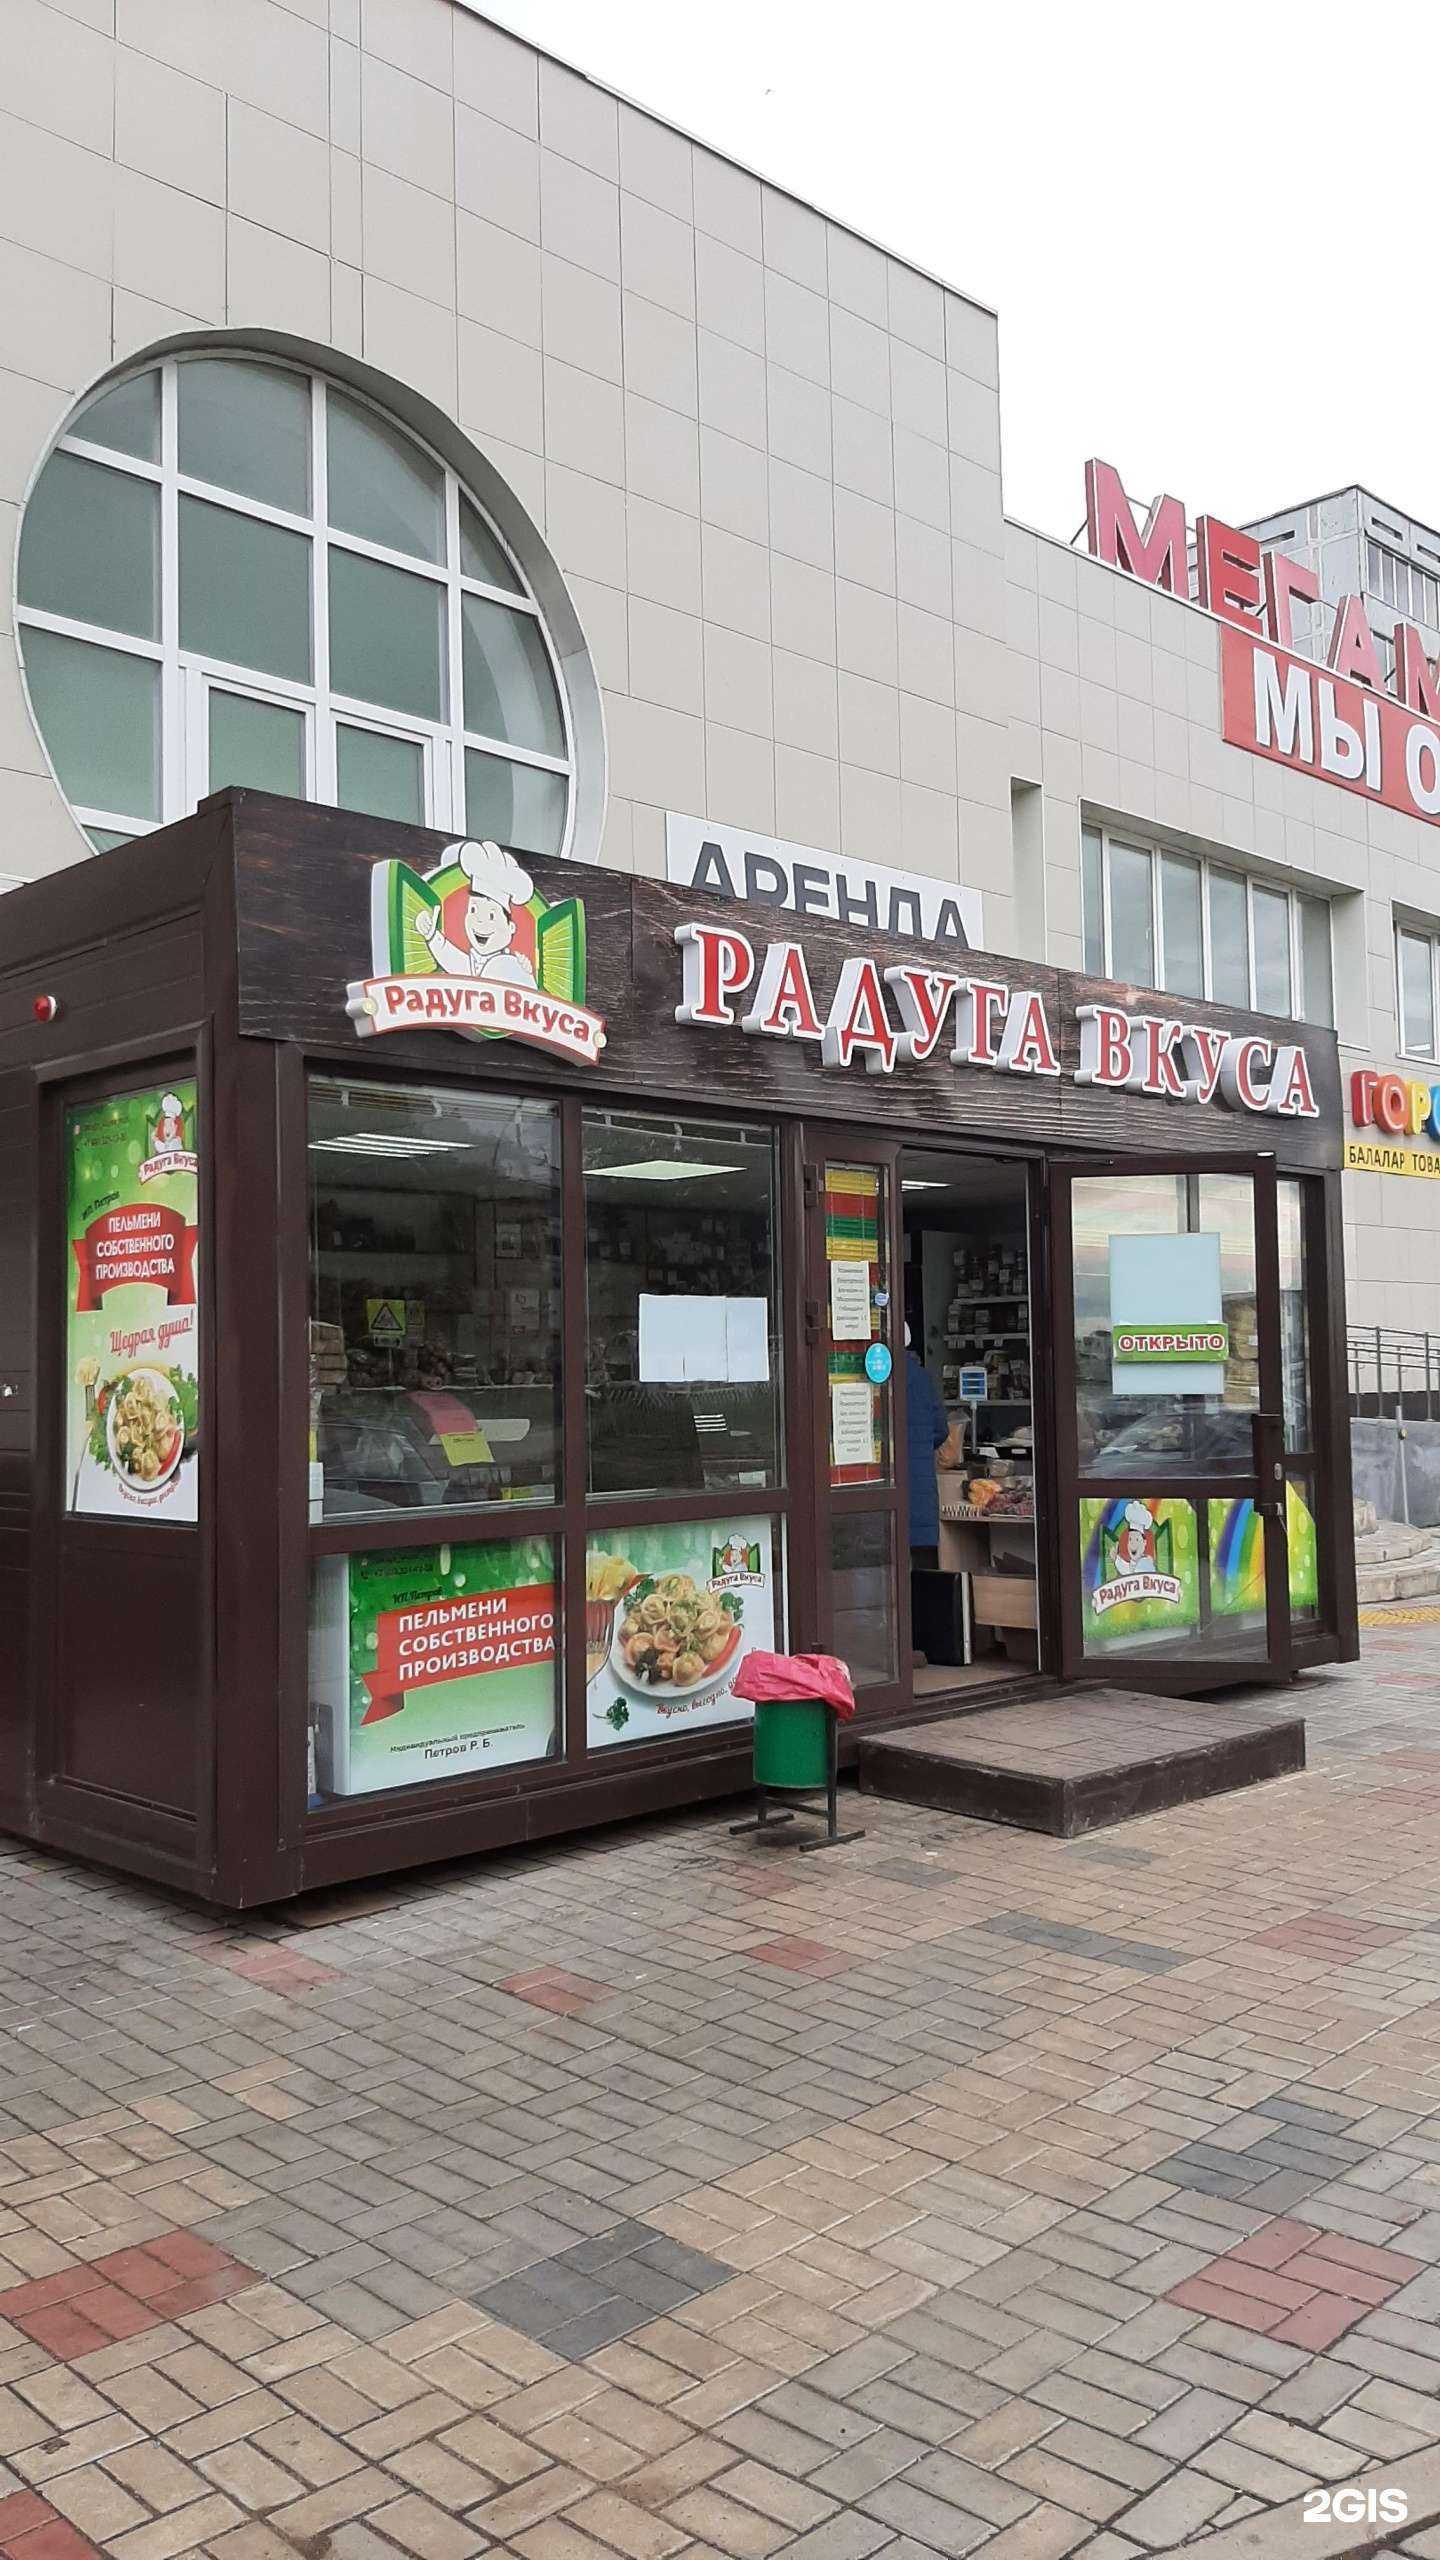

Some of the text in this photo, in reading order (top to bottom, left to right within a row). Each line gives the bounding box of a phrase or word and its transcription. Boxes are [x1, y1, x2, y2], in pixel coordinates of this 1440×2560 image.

[1253, 647, 1382, 792] МЫ
[384, 985, 590, 1043] Радуга Вкуса
[675, 922, 1320, 1118] РАДУГА ВКУСА
[1349, 1146, 1405, 1169] БАЛАЛАР
[108, 1212, 160, 1233] ПЕЛЬМЕНИ
[96, 1233, 175, 1257] СОБСТВЕННОГО
[95, 1257, 175, 1280] ПРОИЗВОДСТВА
[110, 1328, 155, 1358] Щедрая
[1119, 1333, 1225, 1352] ОТКРЫТО
[1099, 1576, 1176, 1604] Радуга Вкуса
[399, 1597, 507, 1633] ПЕЛЬМЕНИ
[399, 1613, 554, 1656] СОБСТВЕННОГО
[399, 1635, 556, 1681] ПРОИЗВОДСТВА
[424, 1744, 467, 1759] Петров
[470, 1740, 479, 1751] Р.
